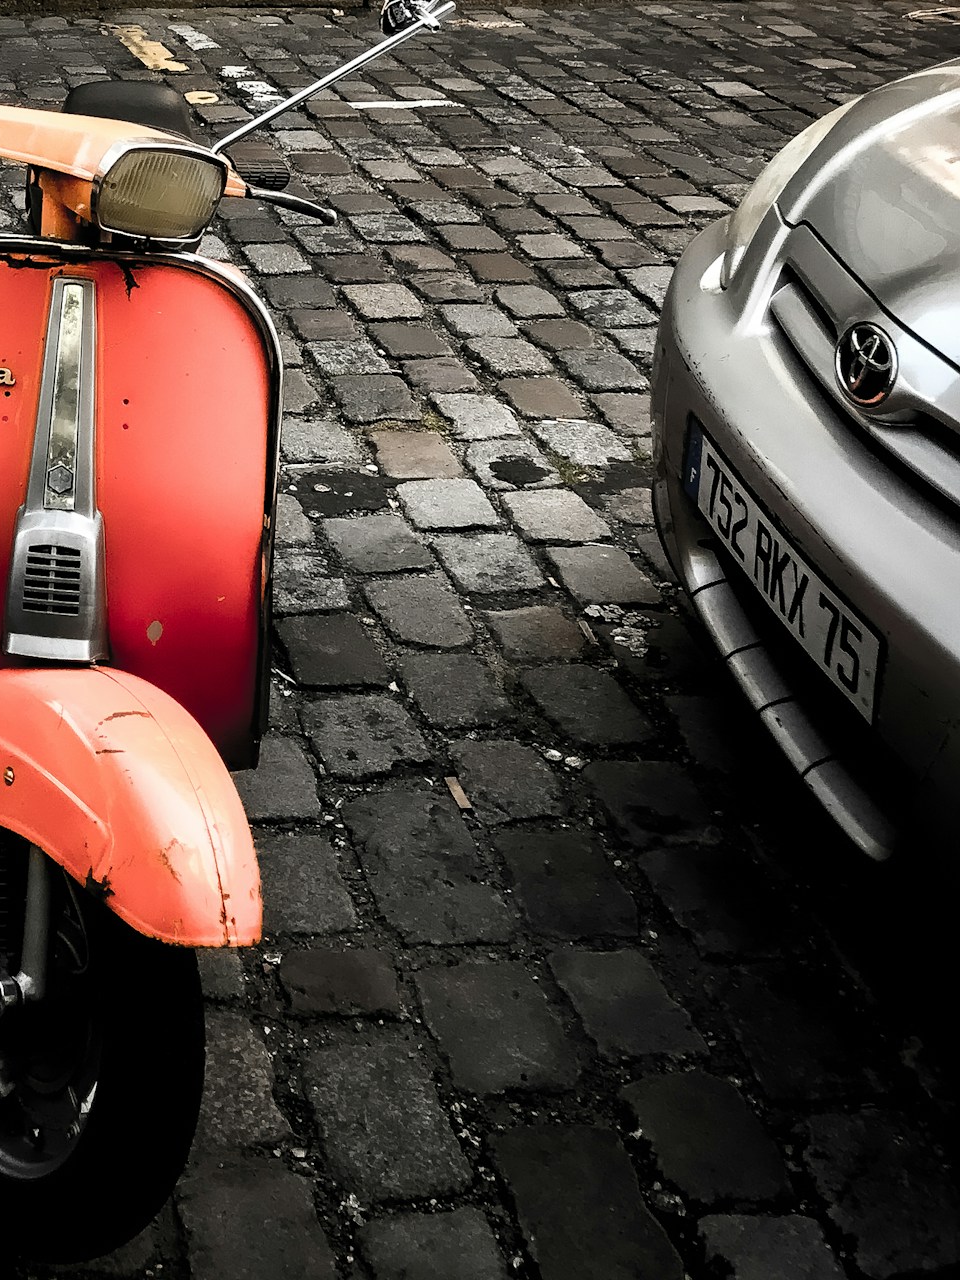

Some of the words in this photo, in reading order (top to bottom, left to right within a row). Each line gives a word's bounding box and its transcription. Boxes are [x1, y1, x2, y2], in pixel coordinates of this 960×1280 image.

[707, 451, 748, 563] 752
[754, 518, 809, 639] RKX
[819, 590, 863, 695] 75
